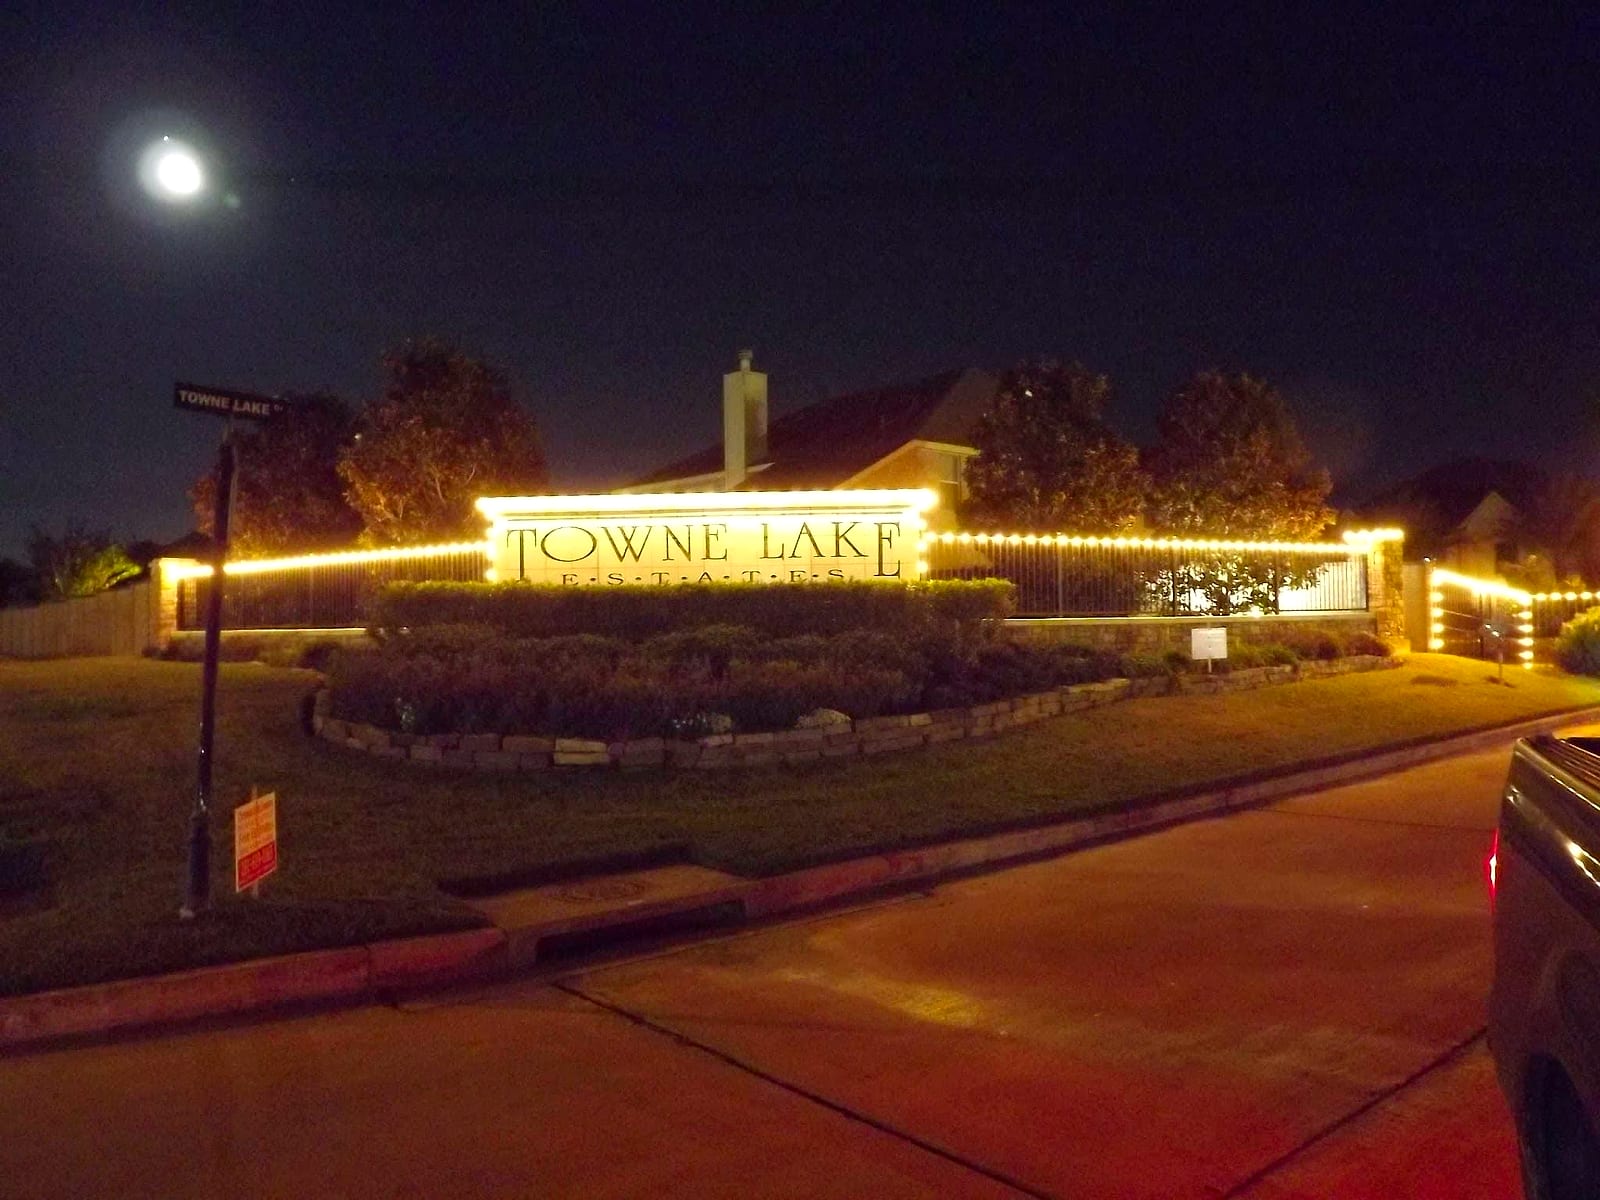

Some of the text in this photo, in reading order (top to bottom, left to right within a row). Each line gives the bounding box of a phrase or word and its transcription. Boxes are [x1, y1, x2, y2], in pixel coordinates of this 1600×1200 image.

[179, 390, 230, 409] TOWNE
[232, 400, 270, 415] LAKE
[506, 521, 901, 582] TOWNE LAKE
